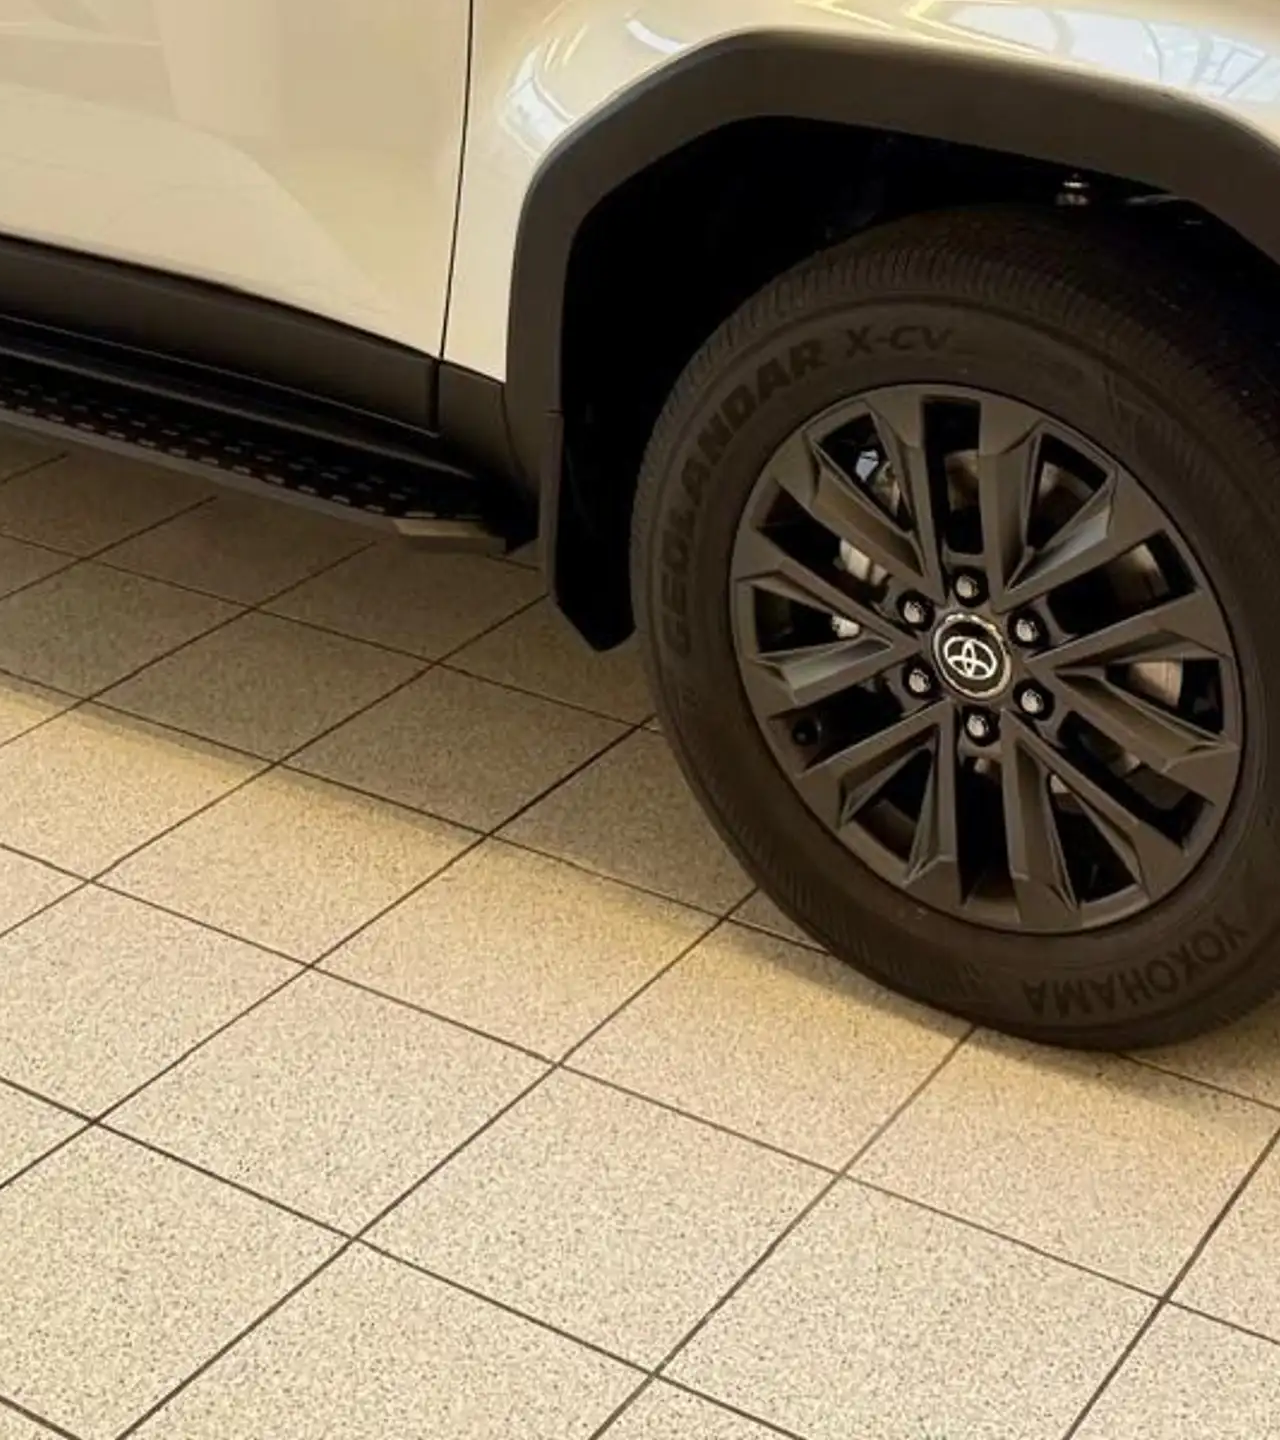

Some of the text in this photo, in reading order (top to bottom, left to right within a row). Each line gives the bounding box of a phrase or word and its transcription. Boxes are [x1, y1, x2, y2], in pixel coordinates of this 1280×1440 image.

[661, 324, 954, 658] GEOLANDAR X-CV
[1020, 915, 1250, 1019] YOKOHAMA
